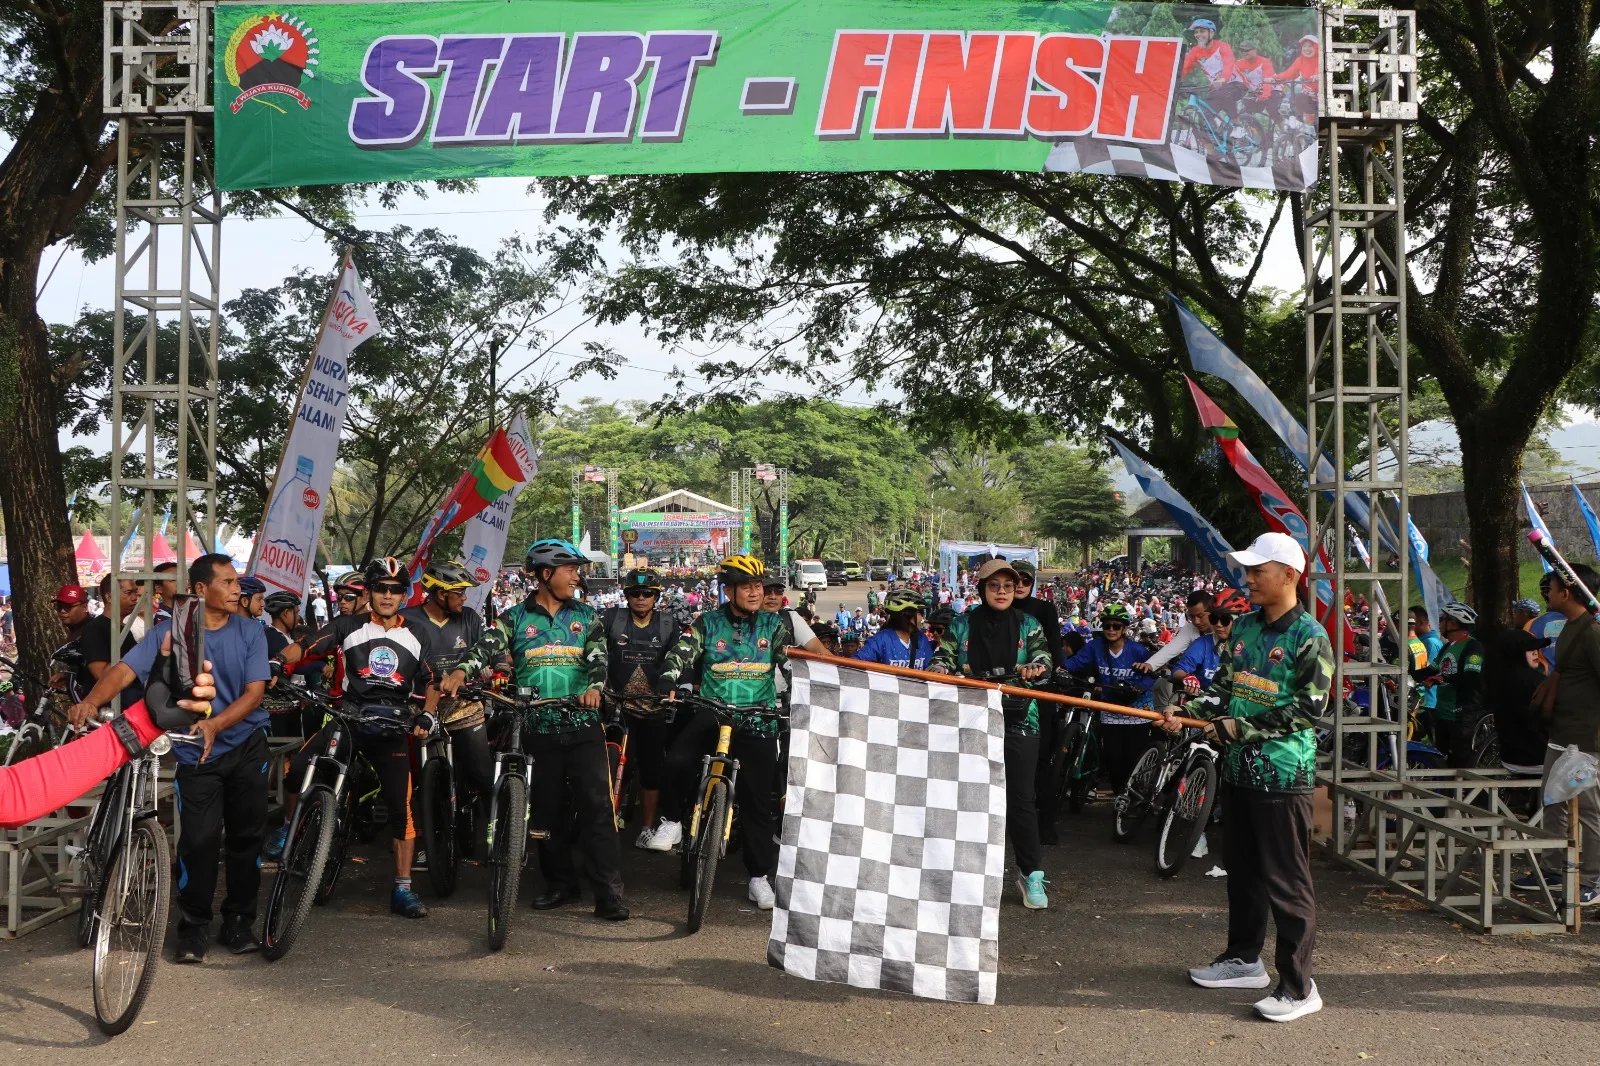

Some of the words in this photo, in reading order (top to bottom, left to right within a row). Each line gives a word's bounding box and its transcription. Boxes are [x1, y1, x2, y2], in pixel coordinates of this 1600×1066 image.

[240, 85, 267, 102] WIJAYA
[267, 85, 300, 98] KUSUMA
[347, 30, 720, 148] START
[814, 28, 1184, 146] FINISH
[306, 378, 347, 407] SEHAT
[297, 403, 336, 433] ALAMI
[476, 511, 506, 532] ALAMI
